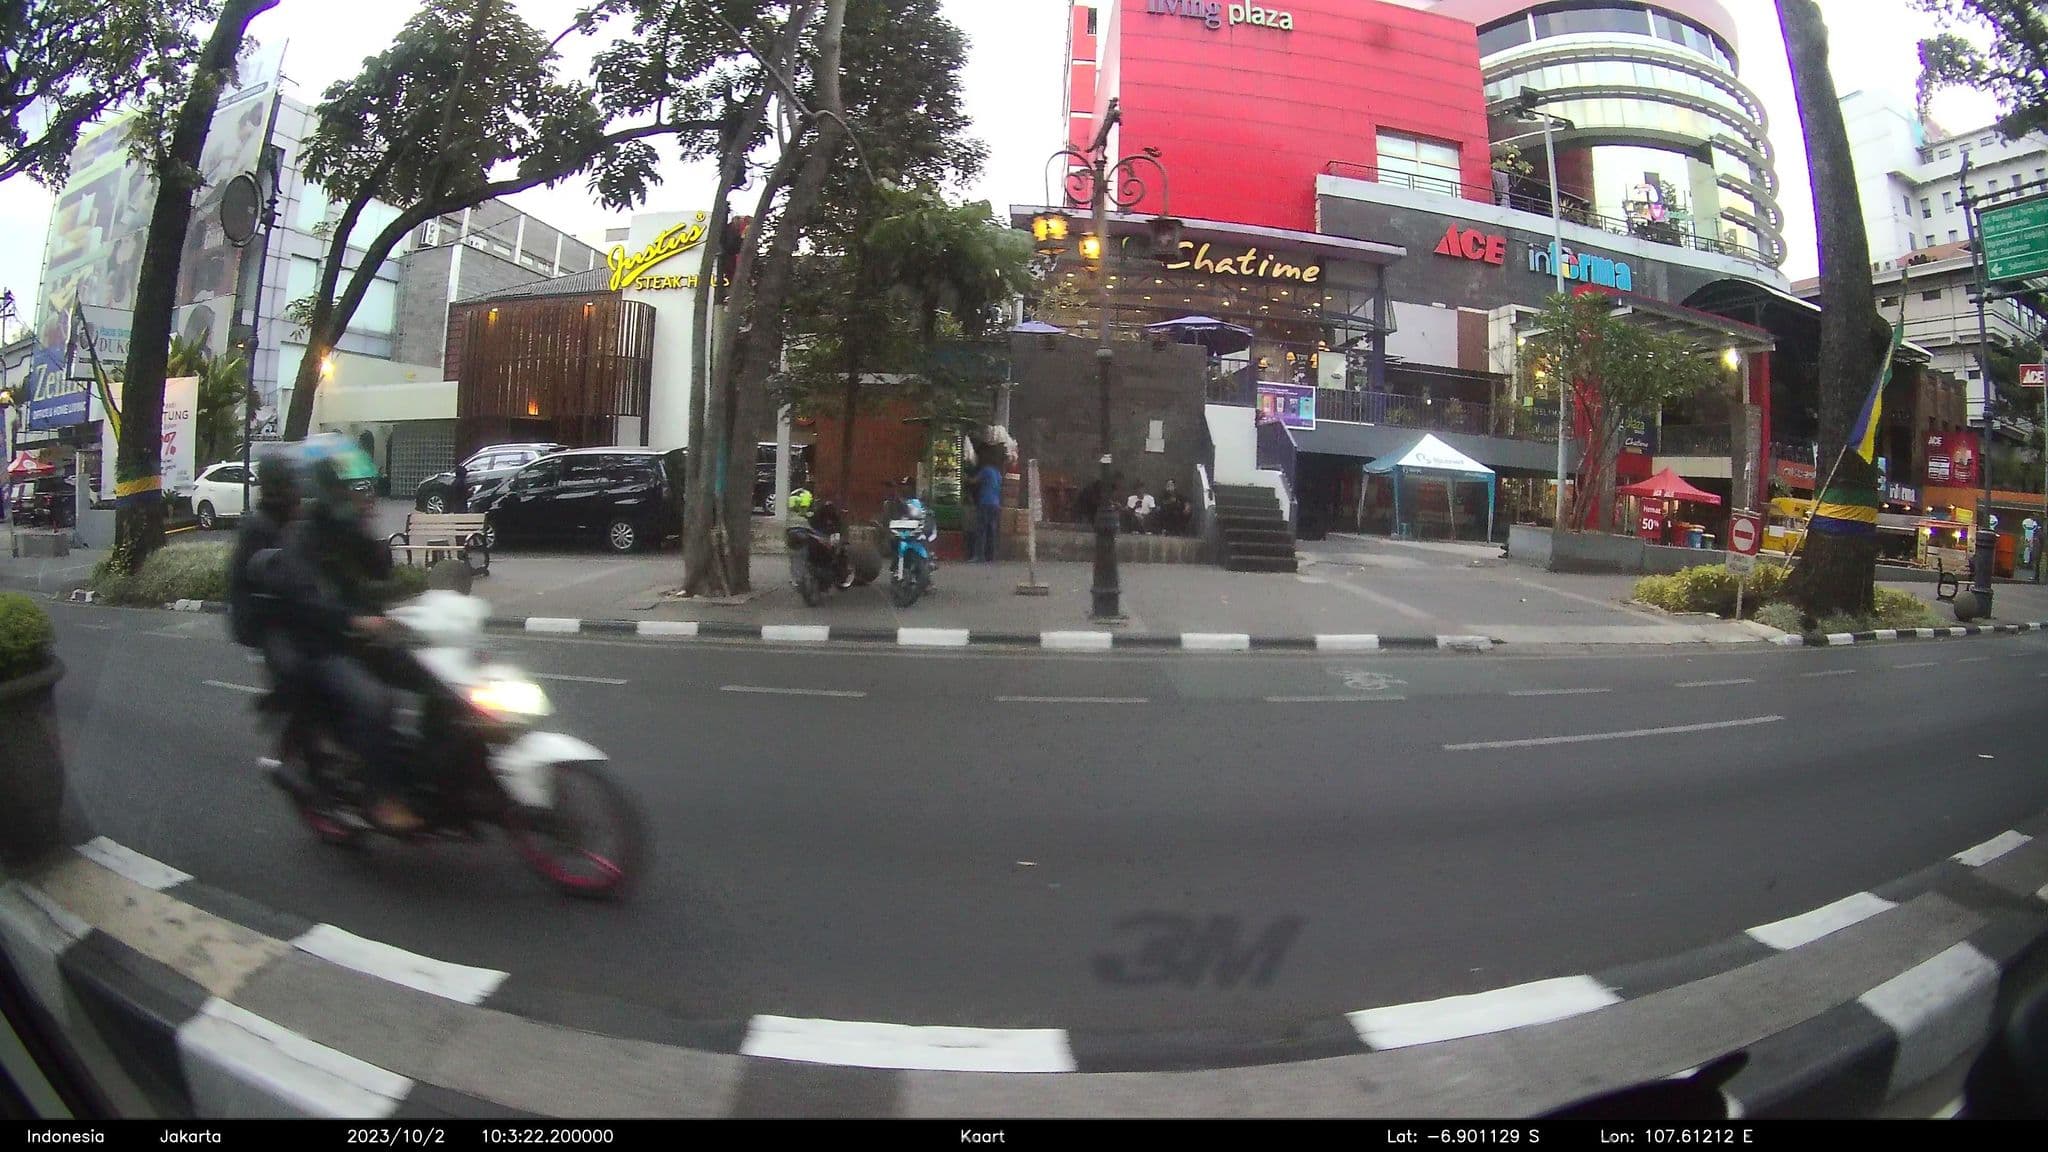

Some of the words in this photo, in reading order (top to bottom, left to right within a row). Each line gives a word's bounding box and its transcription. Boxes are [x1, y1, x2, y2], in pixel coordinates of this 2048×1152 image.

[1228, 0, 1293, 30] plaza
[608, 222, 707, 291] Justus
[1166, 241, 1320, 283] Chatime
[1433, 223, 1506, 265] ACE
[635, 275, 680, 290] STEAK
[1528, 240, 1632, 292] informa
[2022, 369, 2044, 384] ACE
[1642, 518, 1659, 530] 50%
[1092, 909, 1305, 986] 3M
